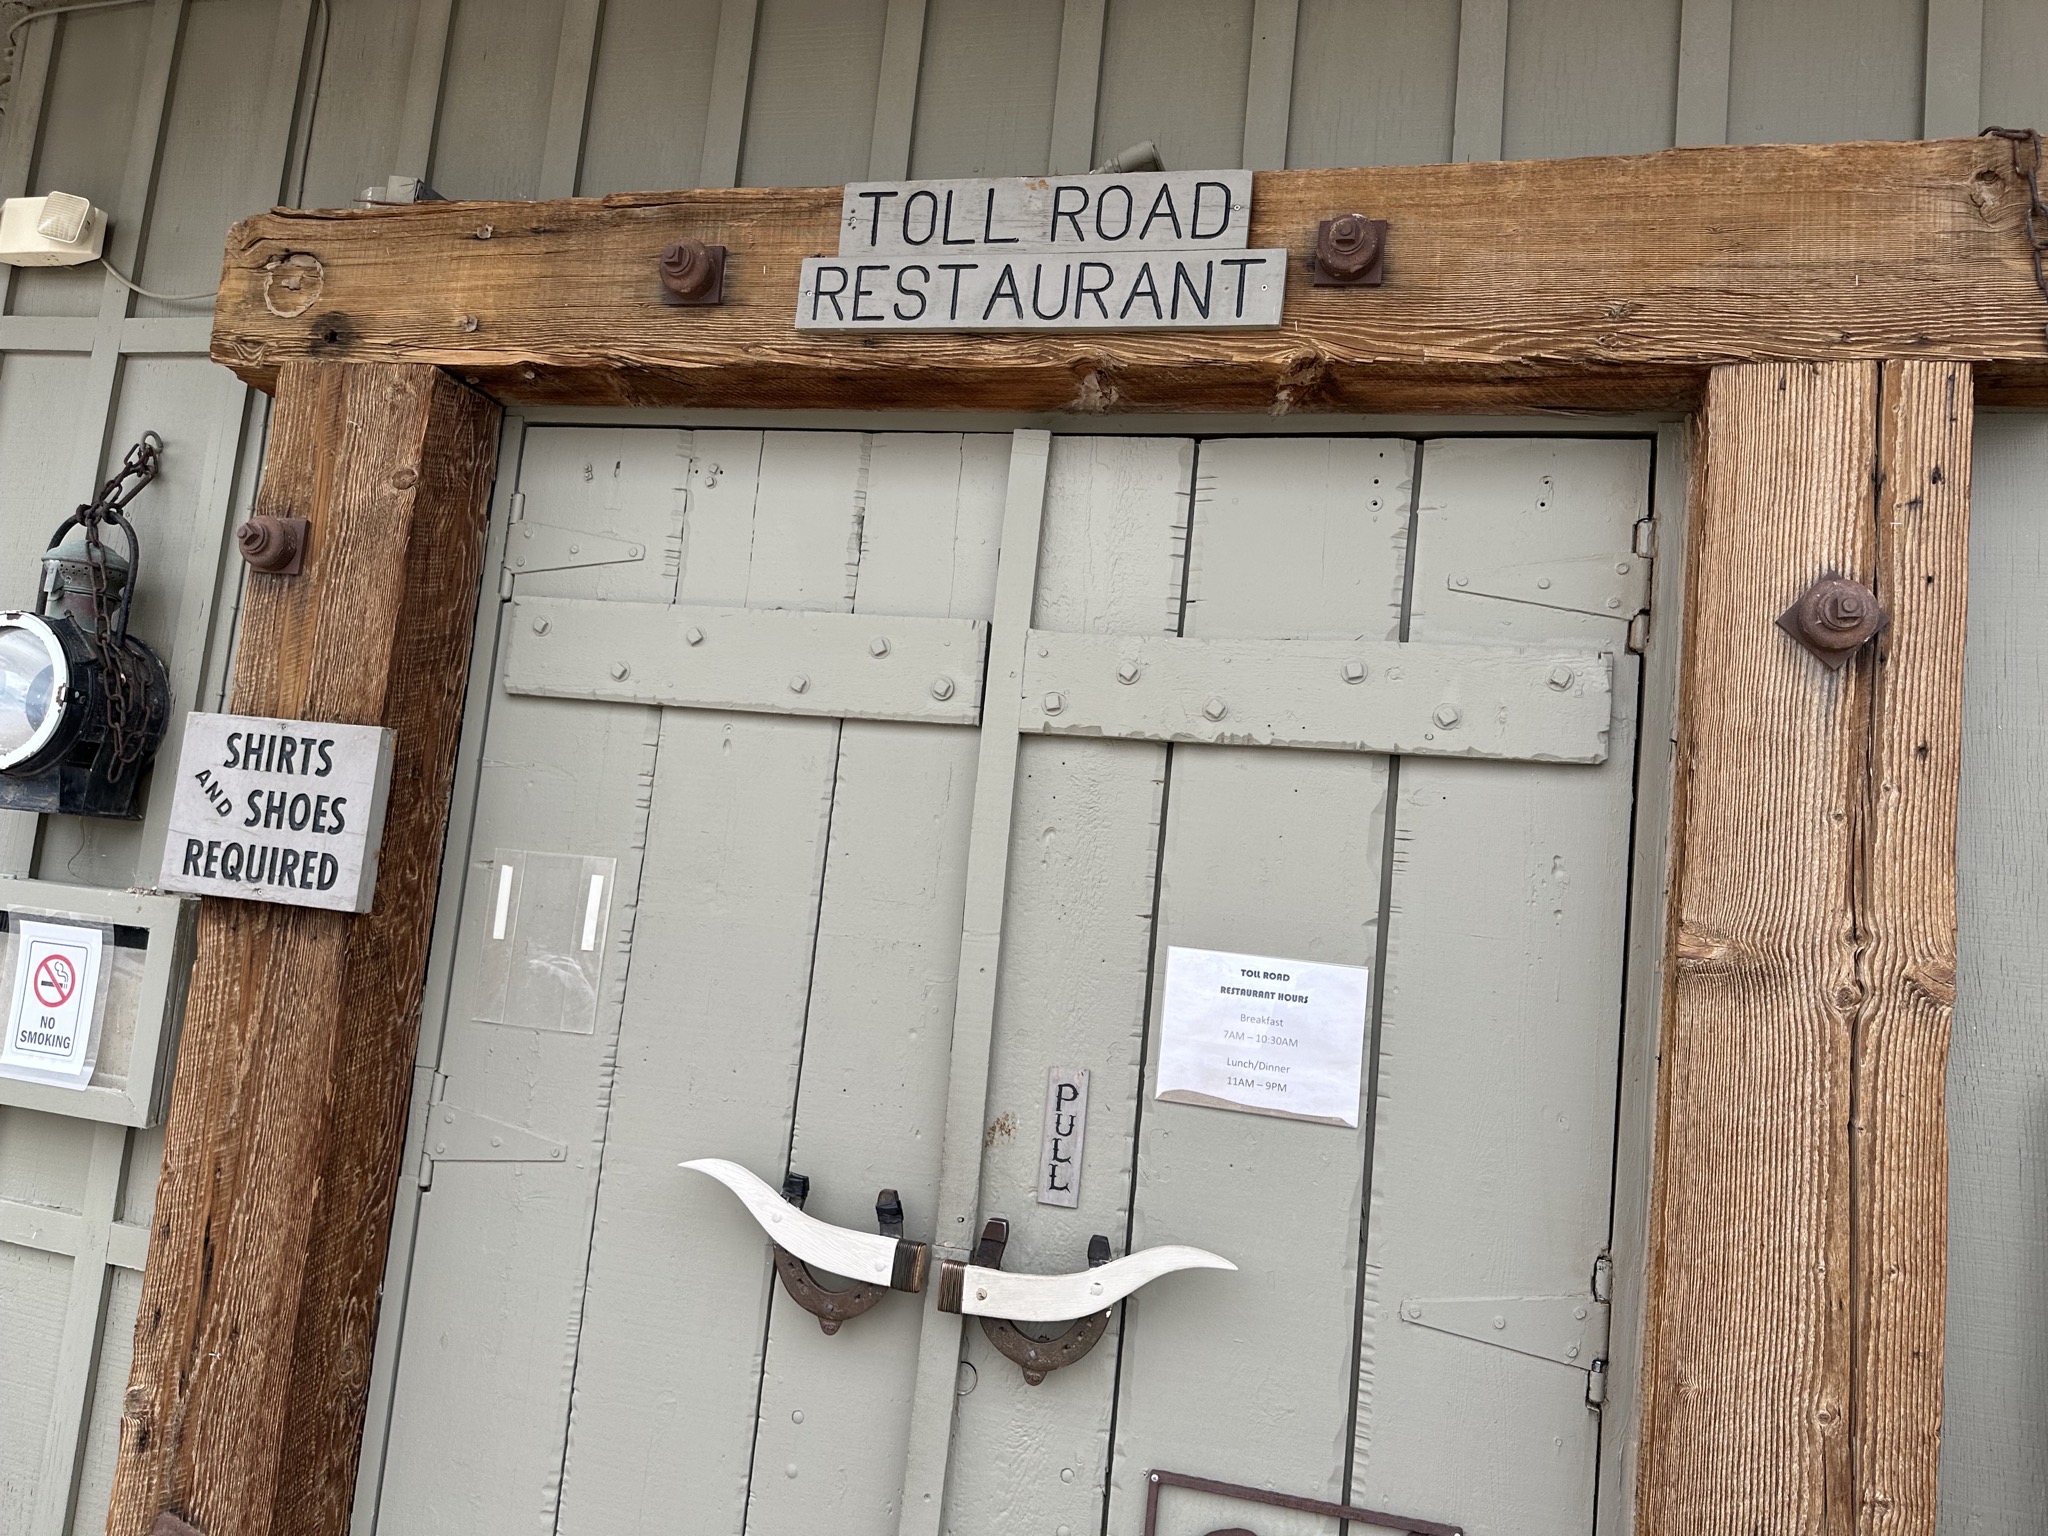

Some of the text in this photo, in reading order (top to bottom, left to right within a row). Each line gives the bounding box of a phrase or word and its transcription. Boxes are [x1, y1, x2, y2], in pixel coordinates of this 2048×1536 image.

[859, 183, 1232, 247] TOLL ROAD
[811, 258, 1267, 321] RESTAURANT
[223, 732, 335, 777] SHIRTS
[195, 769, 233, 817] AND
[244, 789, 347, 835] SHOES
[182, 838, 339, 891] REQUIRED
[1241, 969, 1290, 982] TOLL ROAD
[1220, 986, 1309, 1004] RESTAURANT HOURS
[40, 1015, 55, 1029] NO
[1240, 1013, 1284, 1028] Breakfast
[20, 1030, 71, 1049] SMOKING
[1223, 1030, 1245, 1041] 7AM
[1256, 1034, 1298, 1048] 10:30AM
[1226, 1057, 1290, 1074] Lunch/Dinner
[1227, 1076, 1254, 1089] 11AM
[1265, 1081, 1287, 1093] 9PM
[1048, 1083, 1079, 1193] PULL
